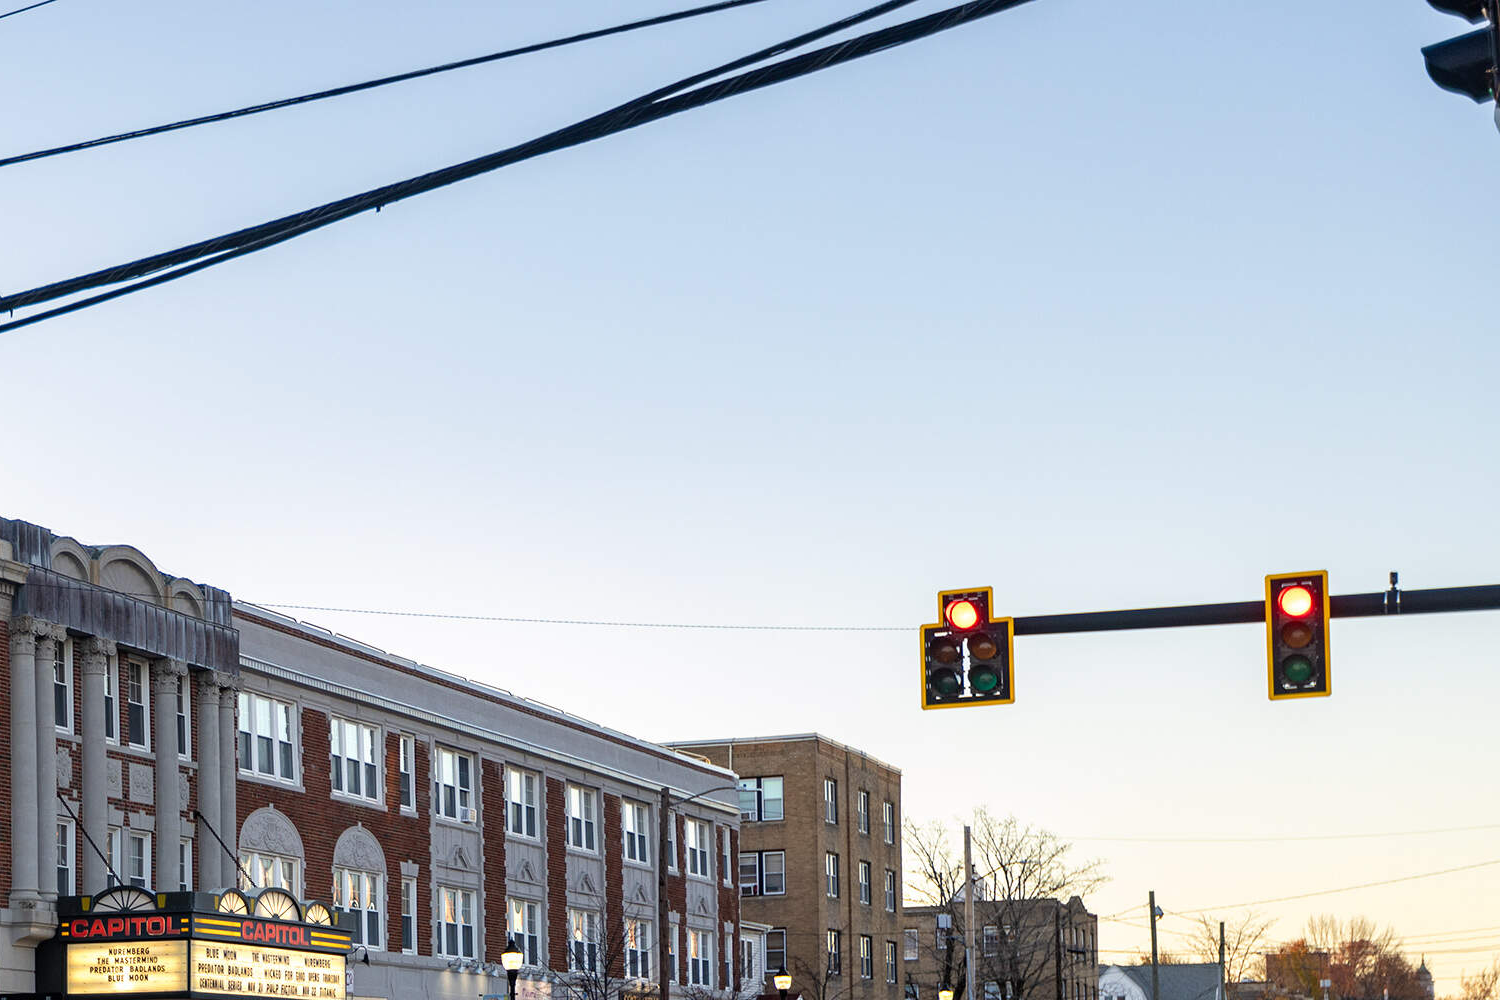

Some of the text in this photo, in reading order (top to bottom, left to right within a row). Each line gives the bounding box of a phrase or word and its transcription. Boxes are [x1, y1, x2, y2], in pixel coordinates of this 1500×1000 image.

[70, 916, 181, 938] CAPITOL
[242, 921, 309, 946] CAPITOL
[108, 947, 150, 956] NUREMBERG
[206, 948, 331, 969] BLUE MOON THE MASTERMIND NUREMBERG
[97, 956, 158, 965] THE MASTERMIND
[89, 965, 165, 974] PREDATOR BADLANDS
[197, 963, 225, 974] PREDATOR
[227, 965, 253, 977] BADLANDS
[264, 969, 281, 980] WICKED
[285, 970, 293, 981] FOR
[108, 974, 124, 983] BLUE
[199, 977, 224, 990] CENTENNIAL
[227, 980, 243, 991] SERIES
[266, 983, 279, 994] PULP
